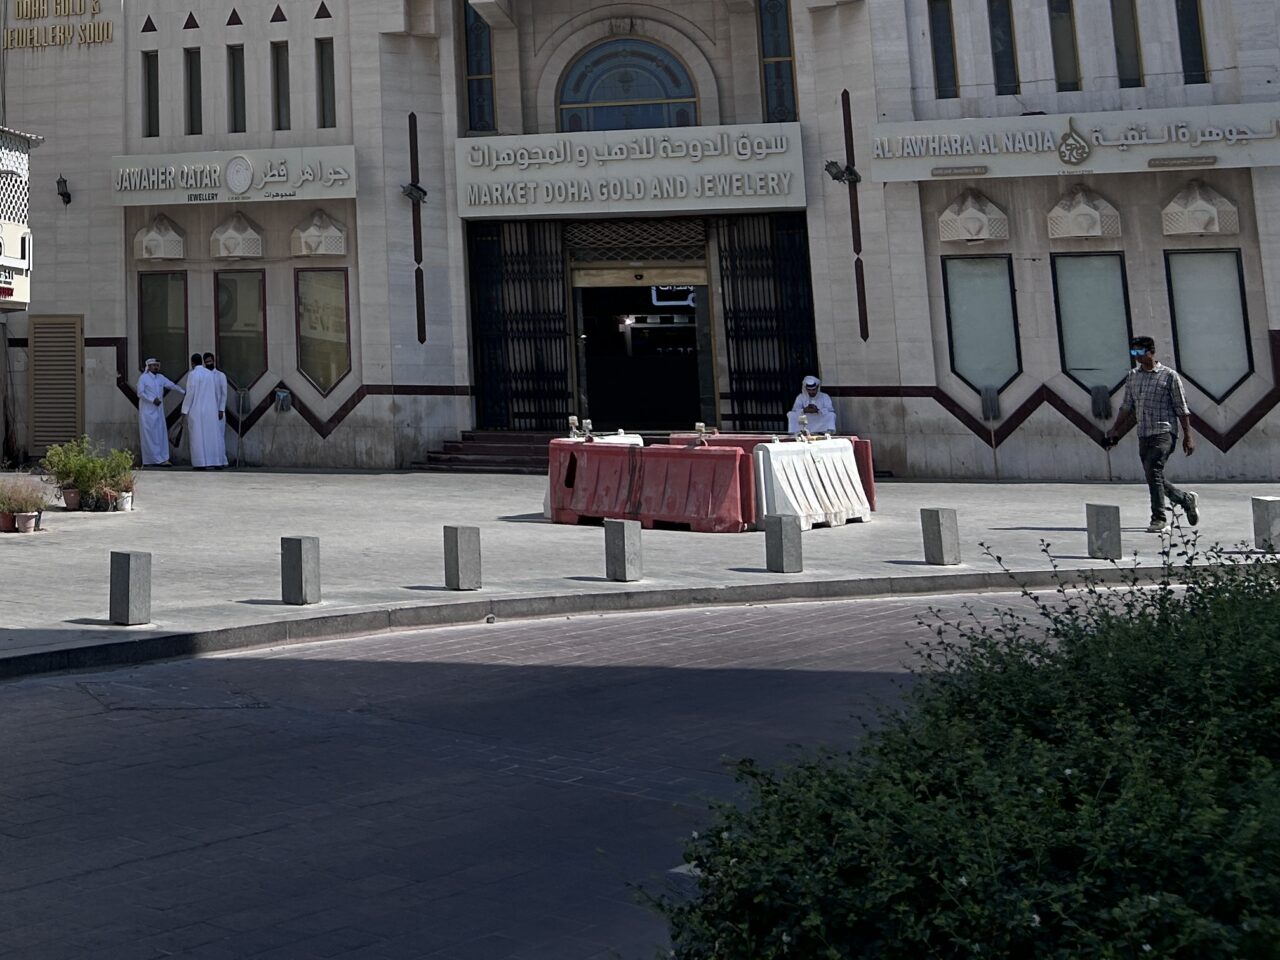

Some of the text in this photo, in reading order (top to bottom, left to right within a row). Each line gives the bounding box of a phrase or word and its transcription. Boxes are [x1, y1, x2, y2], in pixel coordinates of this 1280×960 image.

[3, 24, 74, 49] JEWELLERY
[591, 136, 655, 166] للذهب
[659, 133, 729, 162] الدوحة
[733, 133, 788, 161] سوق
[873, 130, 1057, 159] AL JAWHARA AL NAQIA
[115, 163, 221, 192] JAWAHER QATAR
[253, 159, 350, 190] جواهر قطر
[467, 171, 793, 206] MARKET DOHA GOLD AND JEWELERY
[187, 192, 219, 203] JEWELLERY
